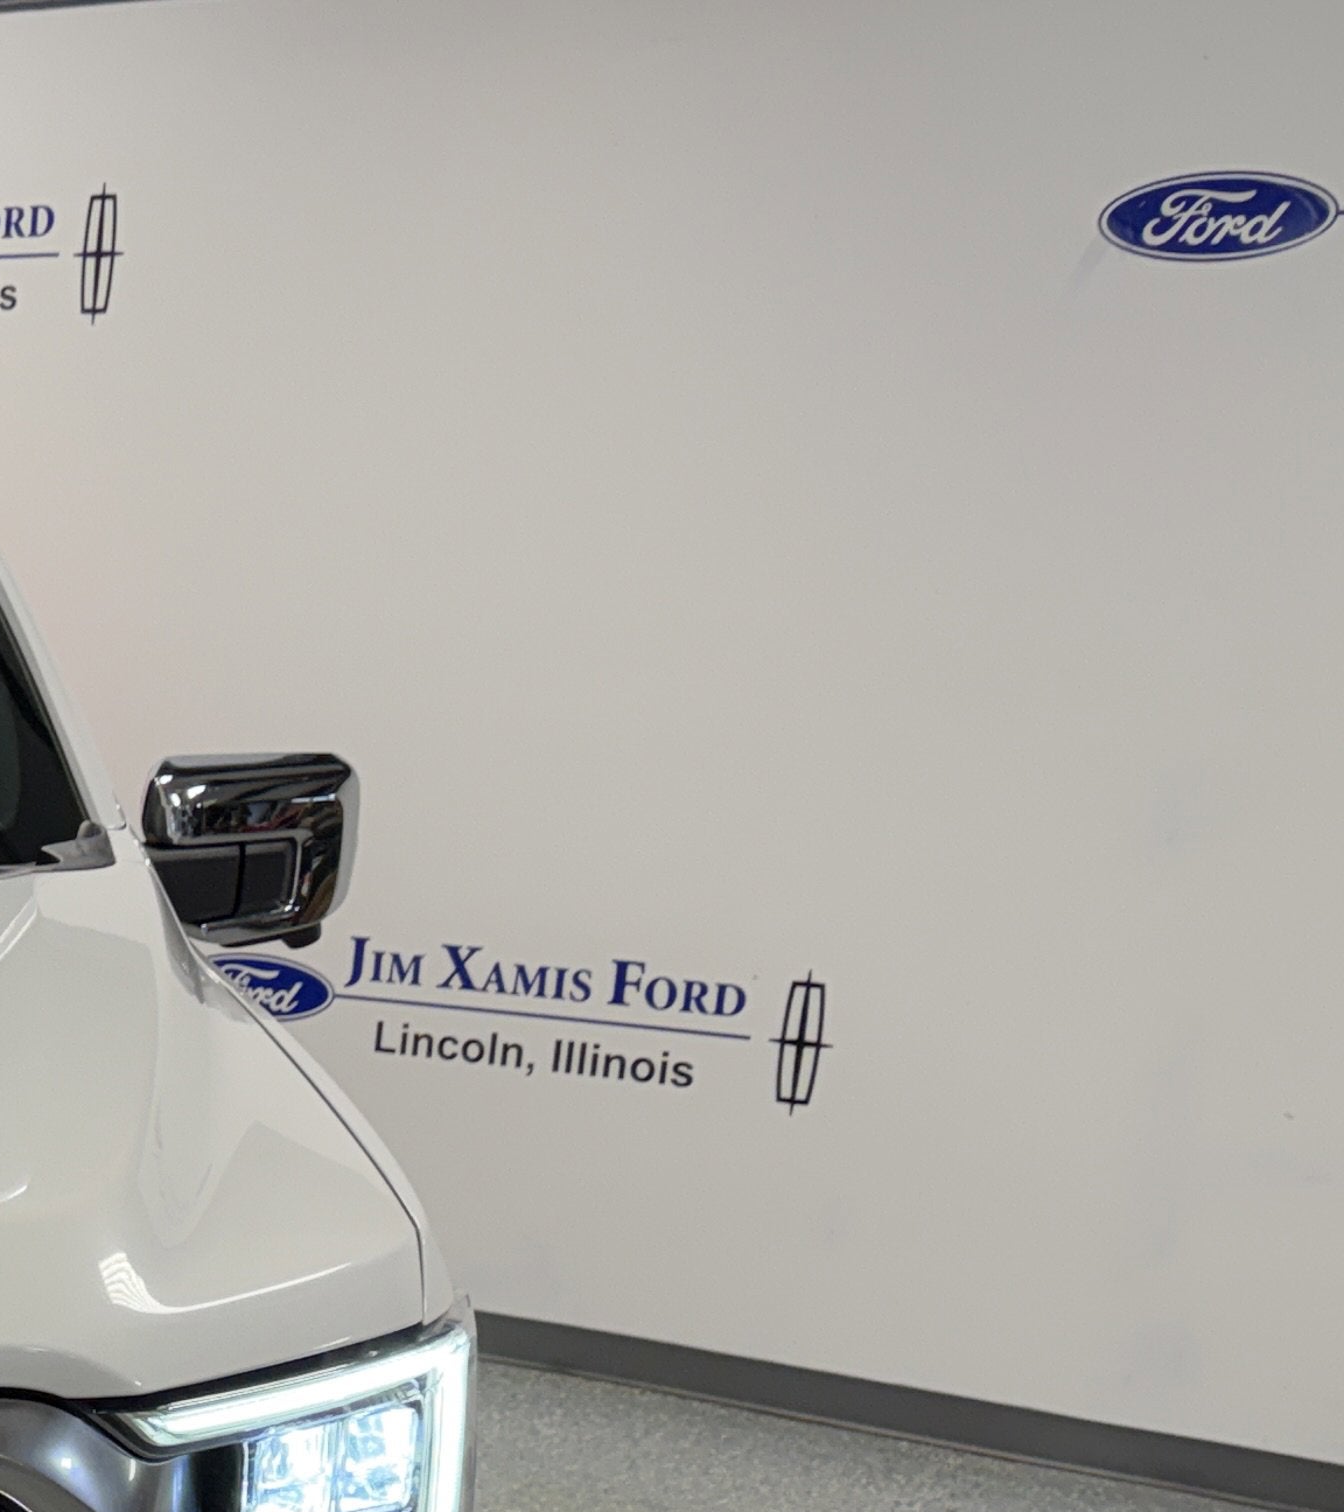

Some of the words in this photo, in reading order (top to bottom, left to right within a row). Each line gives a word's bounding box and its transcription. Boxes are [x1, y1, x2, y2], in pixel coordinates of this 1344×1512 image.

[1142, 188, 1291, 247] Ford
[373, 1020, 536, 1076] Lincoln,
[551, 1039, 695, 1089] Illinois
